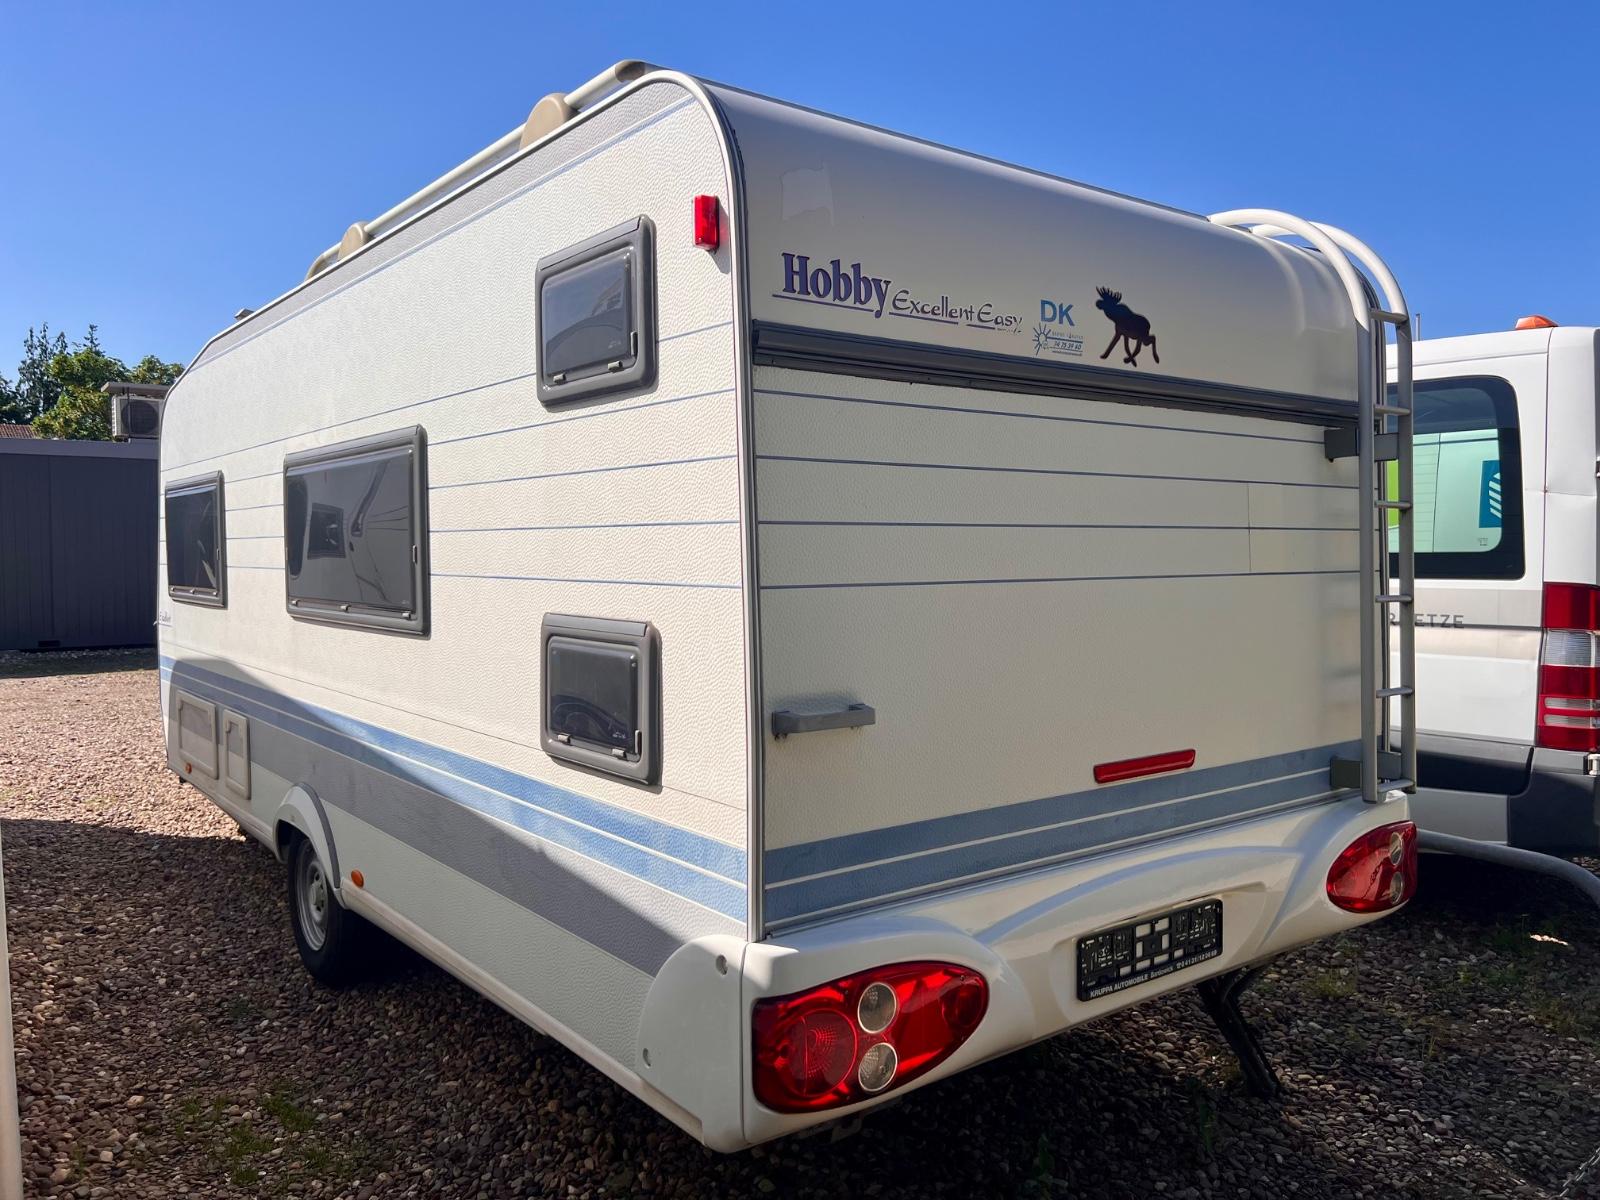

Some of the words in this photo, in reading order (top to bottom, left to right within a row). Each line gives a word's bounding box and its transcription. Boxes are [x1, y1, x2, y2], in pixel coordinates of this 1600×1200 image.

[782, 252, 891, 318] Hobby
[892, 289, 975, 321] Excellent
[1040, 299, 1075, 327] DK
[1090, 985, 1113, 998] KRUPPA
[1114, 973, 1149, 990] AUTOMOBILE
